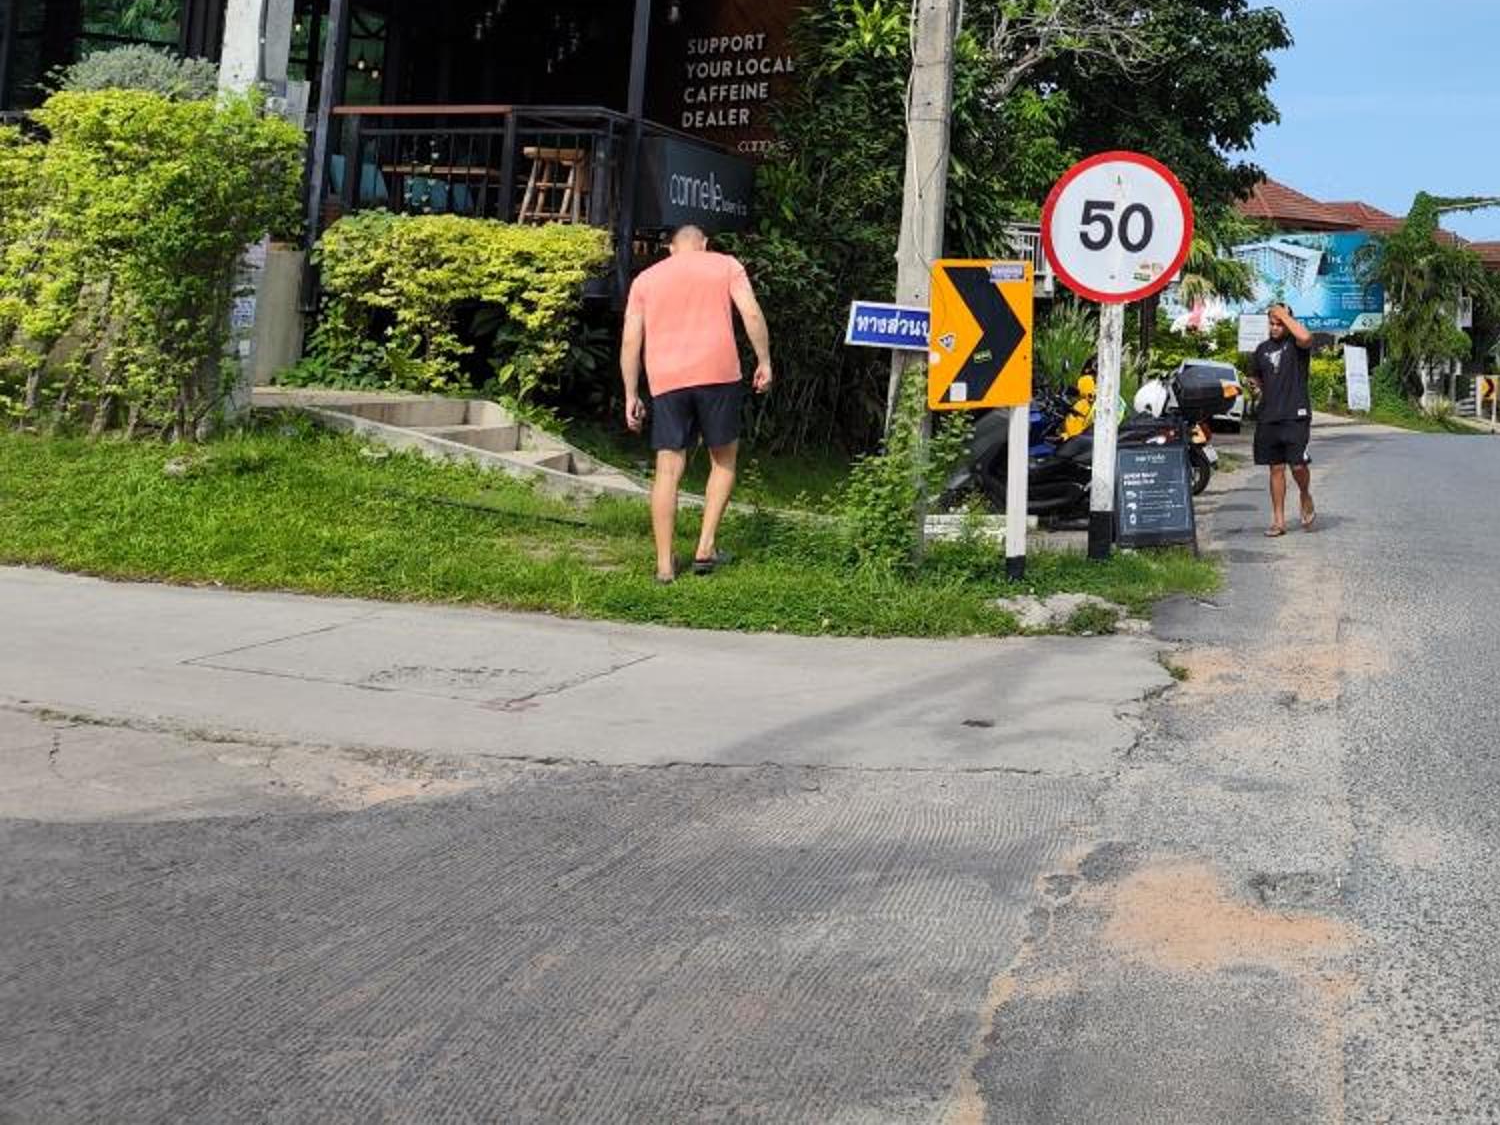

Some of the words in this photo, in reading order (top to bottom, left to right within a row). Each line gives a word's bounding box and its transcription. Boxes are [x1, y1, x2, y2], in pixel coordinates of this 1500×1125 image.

[687, 35, 766, 54] SUPPORT
[687, 61, 733, 78] YOUR
[736, 56, 794, 75] LOCAL
[684, 82, 769, 103] CAFFEINE
[682, 108, 750, 127] DEALER
[1080, 200, 1153, 253] 50
